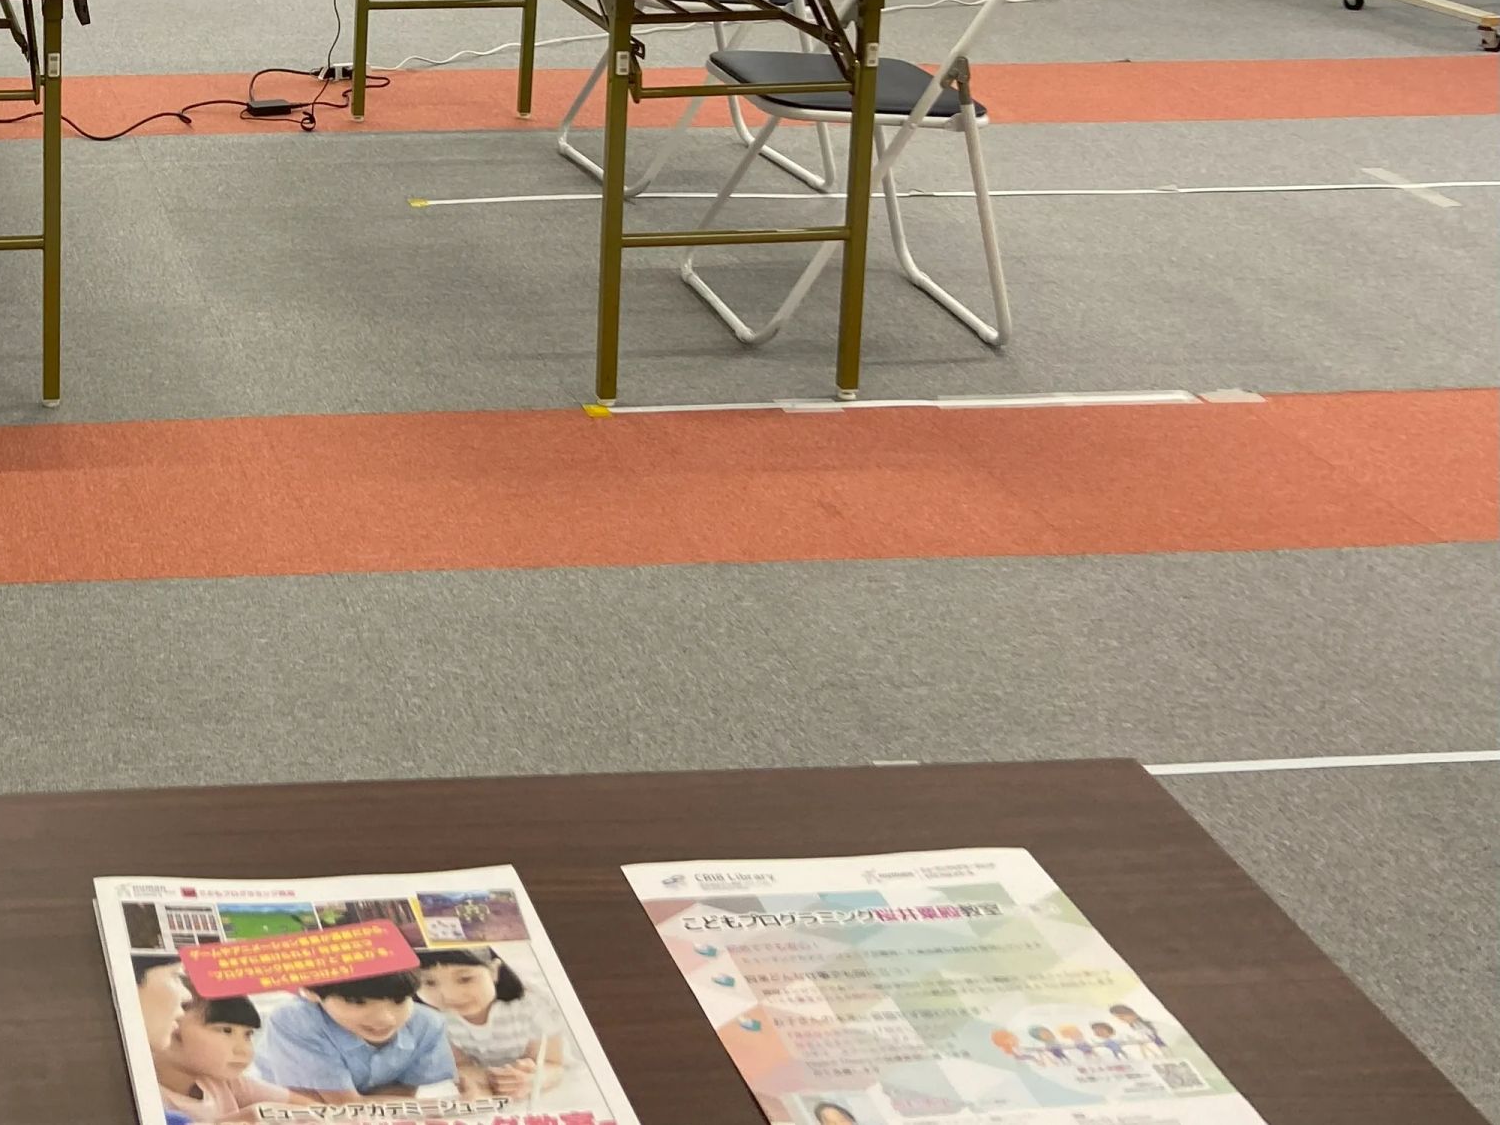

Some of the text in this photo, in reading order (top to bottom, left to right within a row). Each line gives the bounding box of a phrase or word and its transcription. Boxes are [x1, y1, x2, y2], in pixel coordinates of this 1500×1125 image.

[258, 1097, 510, 1120] ヒューマンアカデミージュニア
